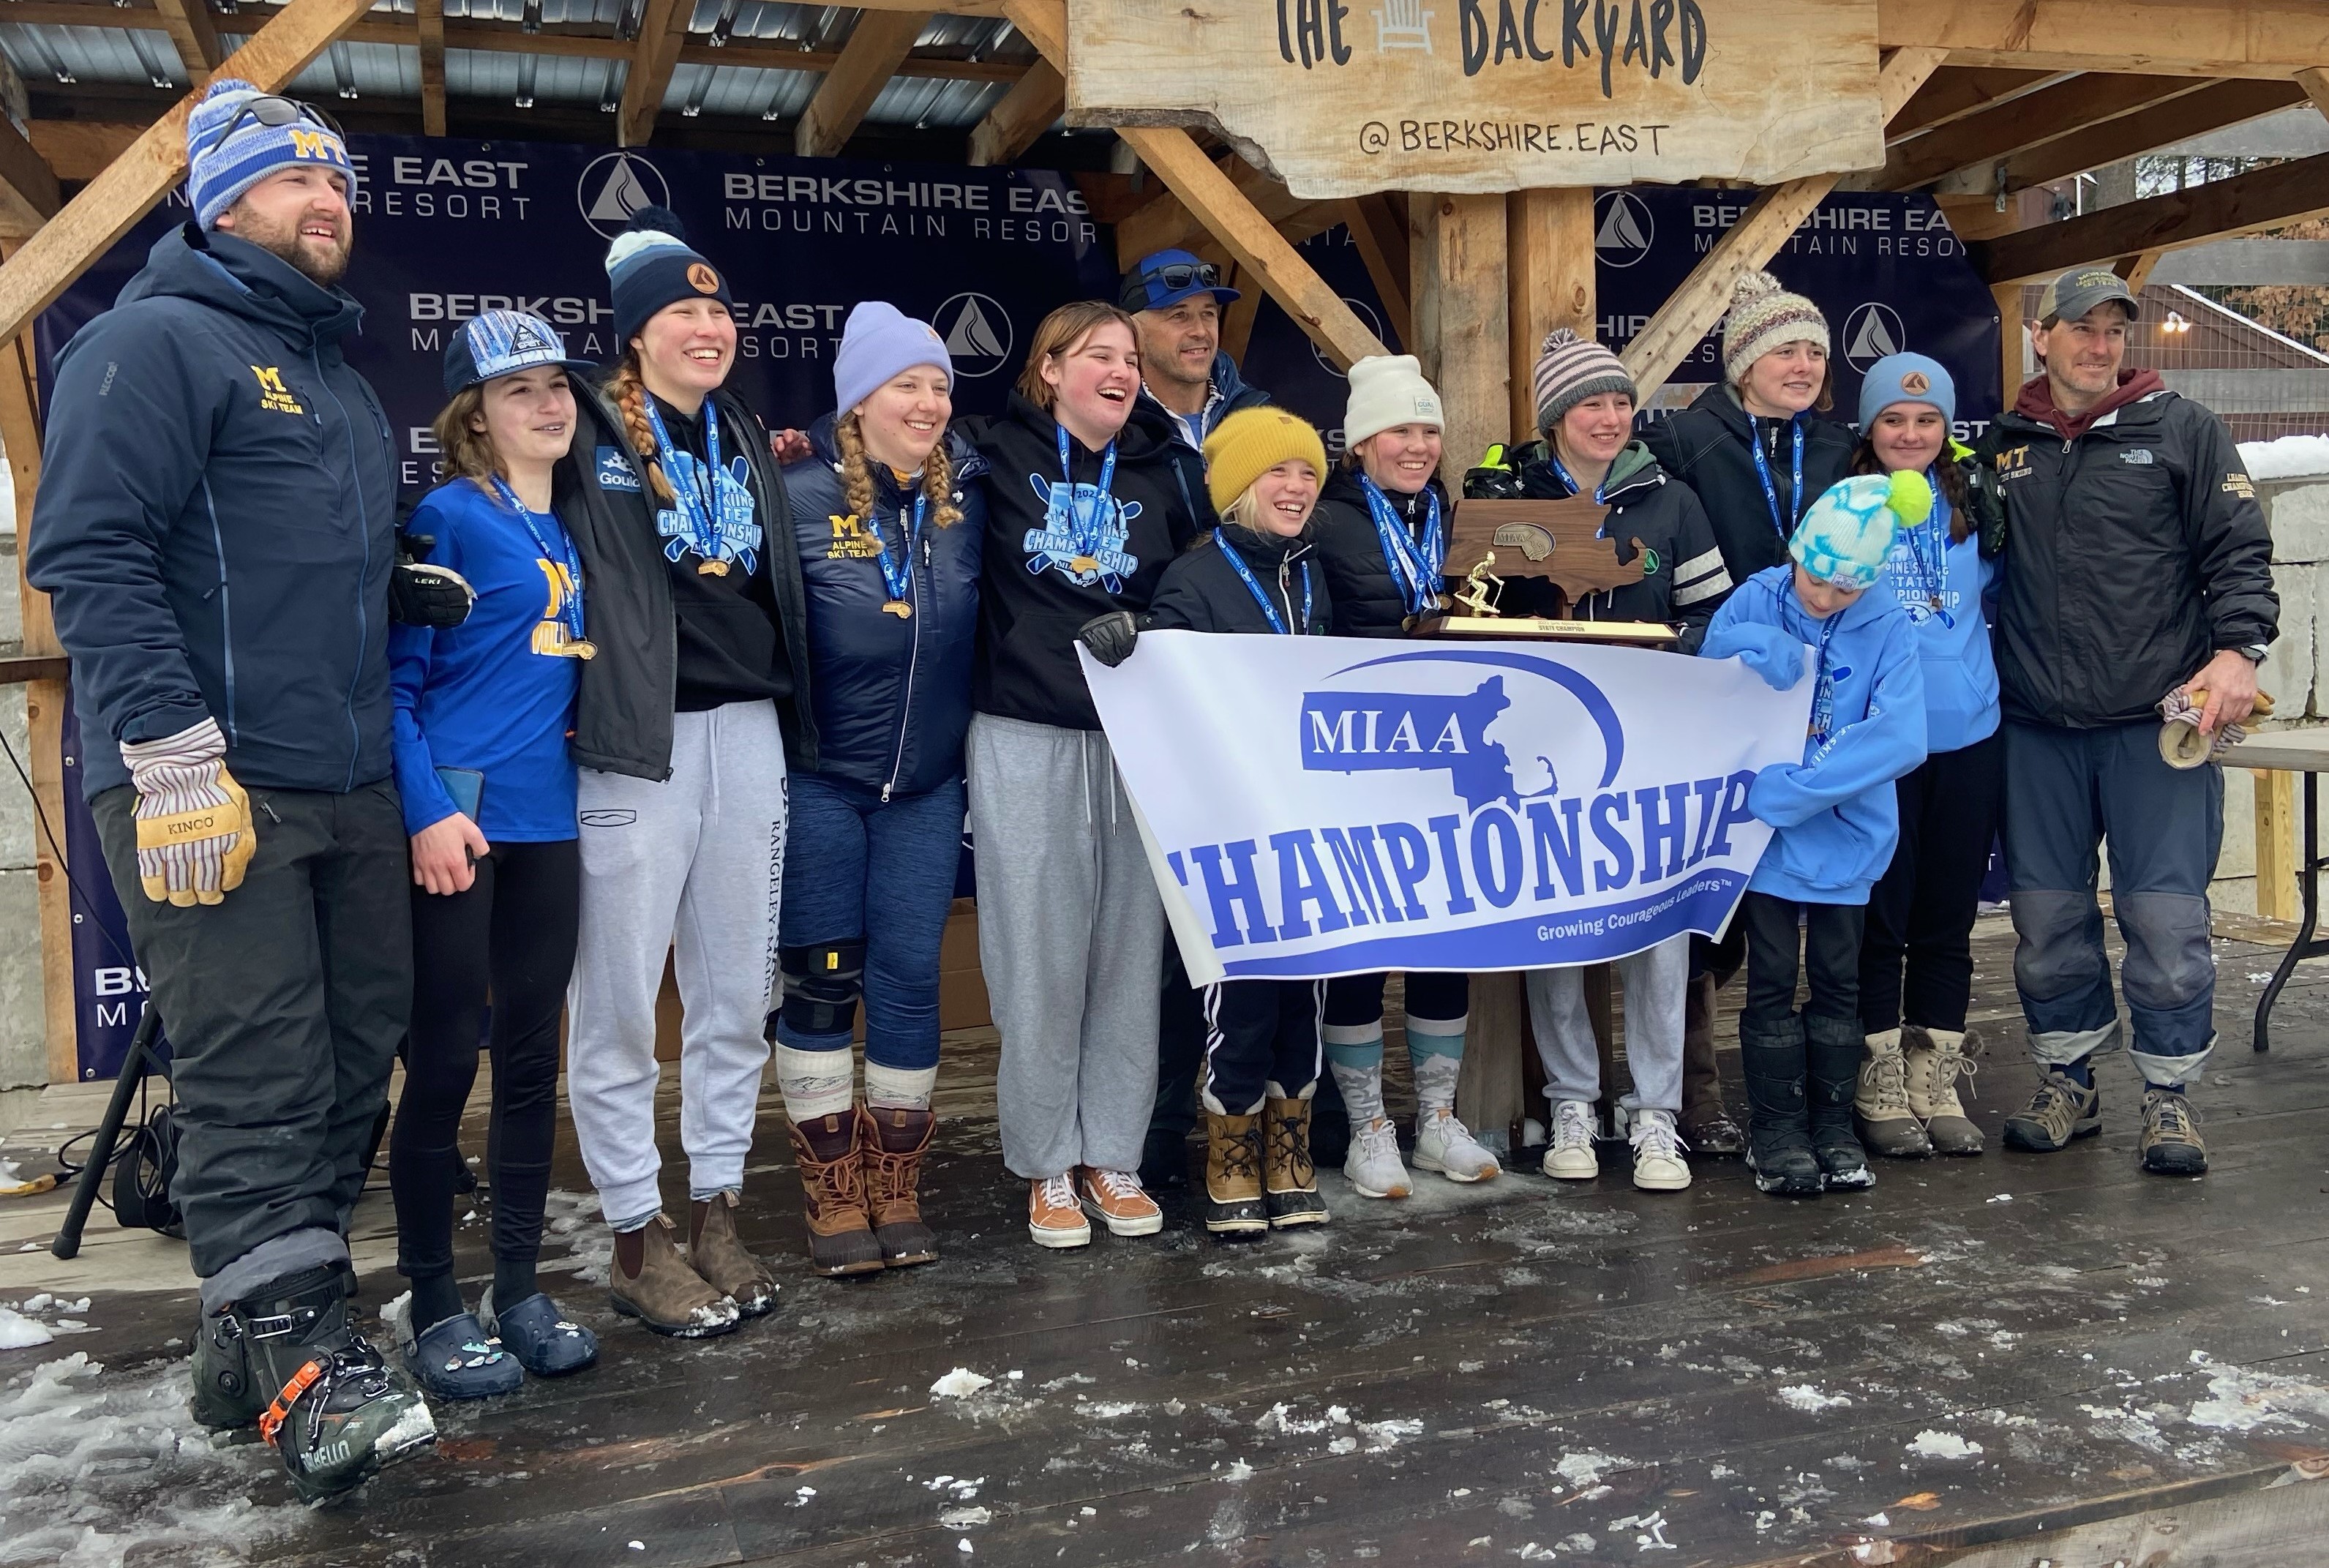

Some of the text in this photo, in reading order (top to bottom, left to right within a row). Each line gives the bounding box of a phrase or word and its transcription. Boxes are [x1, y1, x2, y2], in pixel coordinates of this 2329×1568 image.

[394, 156, 528, 189] EAST
[724, 173, 1090, 214] BERKSHIRE EAS
[726, 206, 1096, 244] MOUNTAIN RESOR
[260, 399, 304, 415] SKI TEAM
[828, 514, 862, 538] M
[827, 551, 845, 559] SKI
[1307, 708, 1470, 754] MIAA
[1166, 768, 1759, 950] HAMPIONSHIP
[1537, 918, 1605, 942] Growing
[1608, 893, 1676, 930] Courageous
